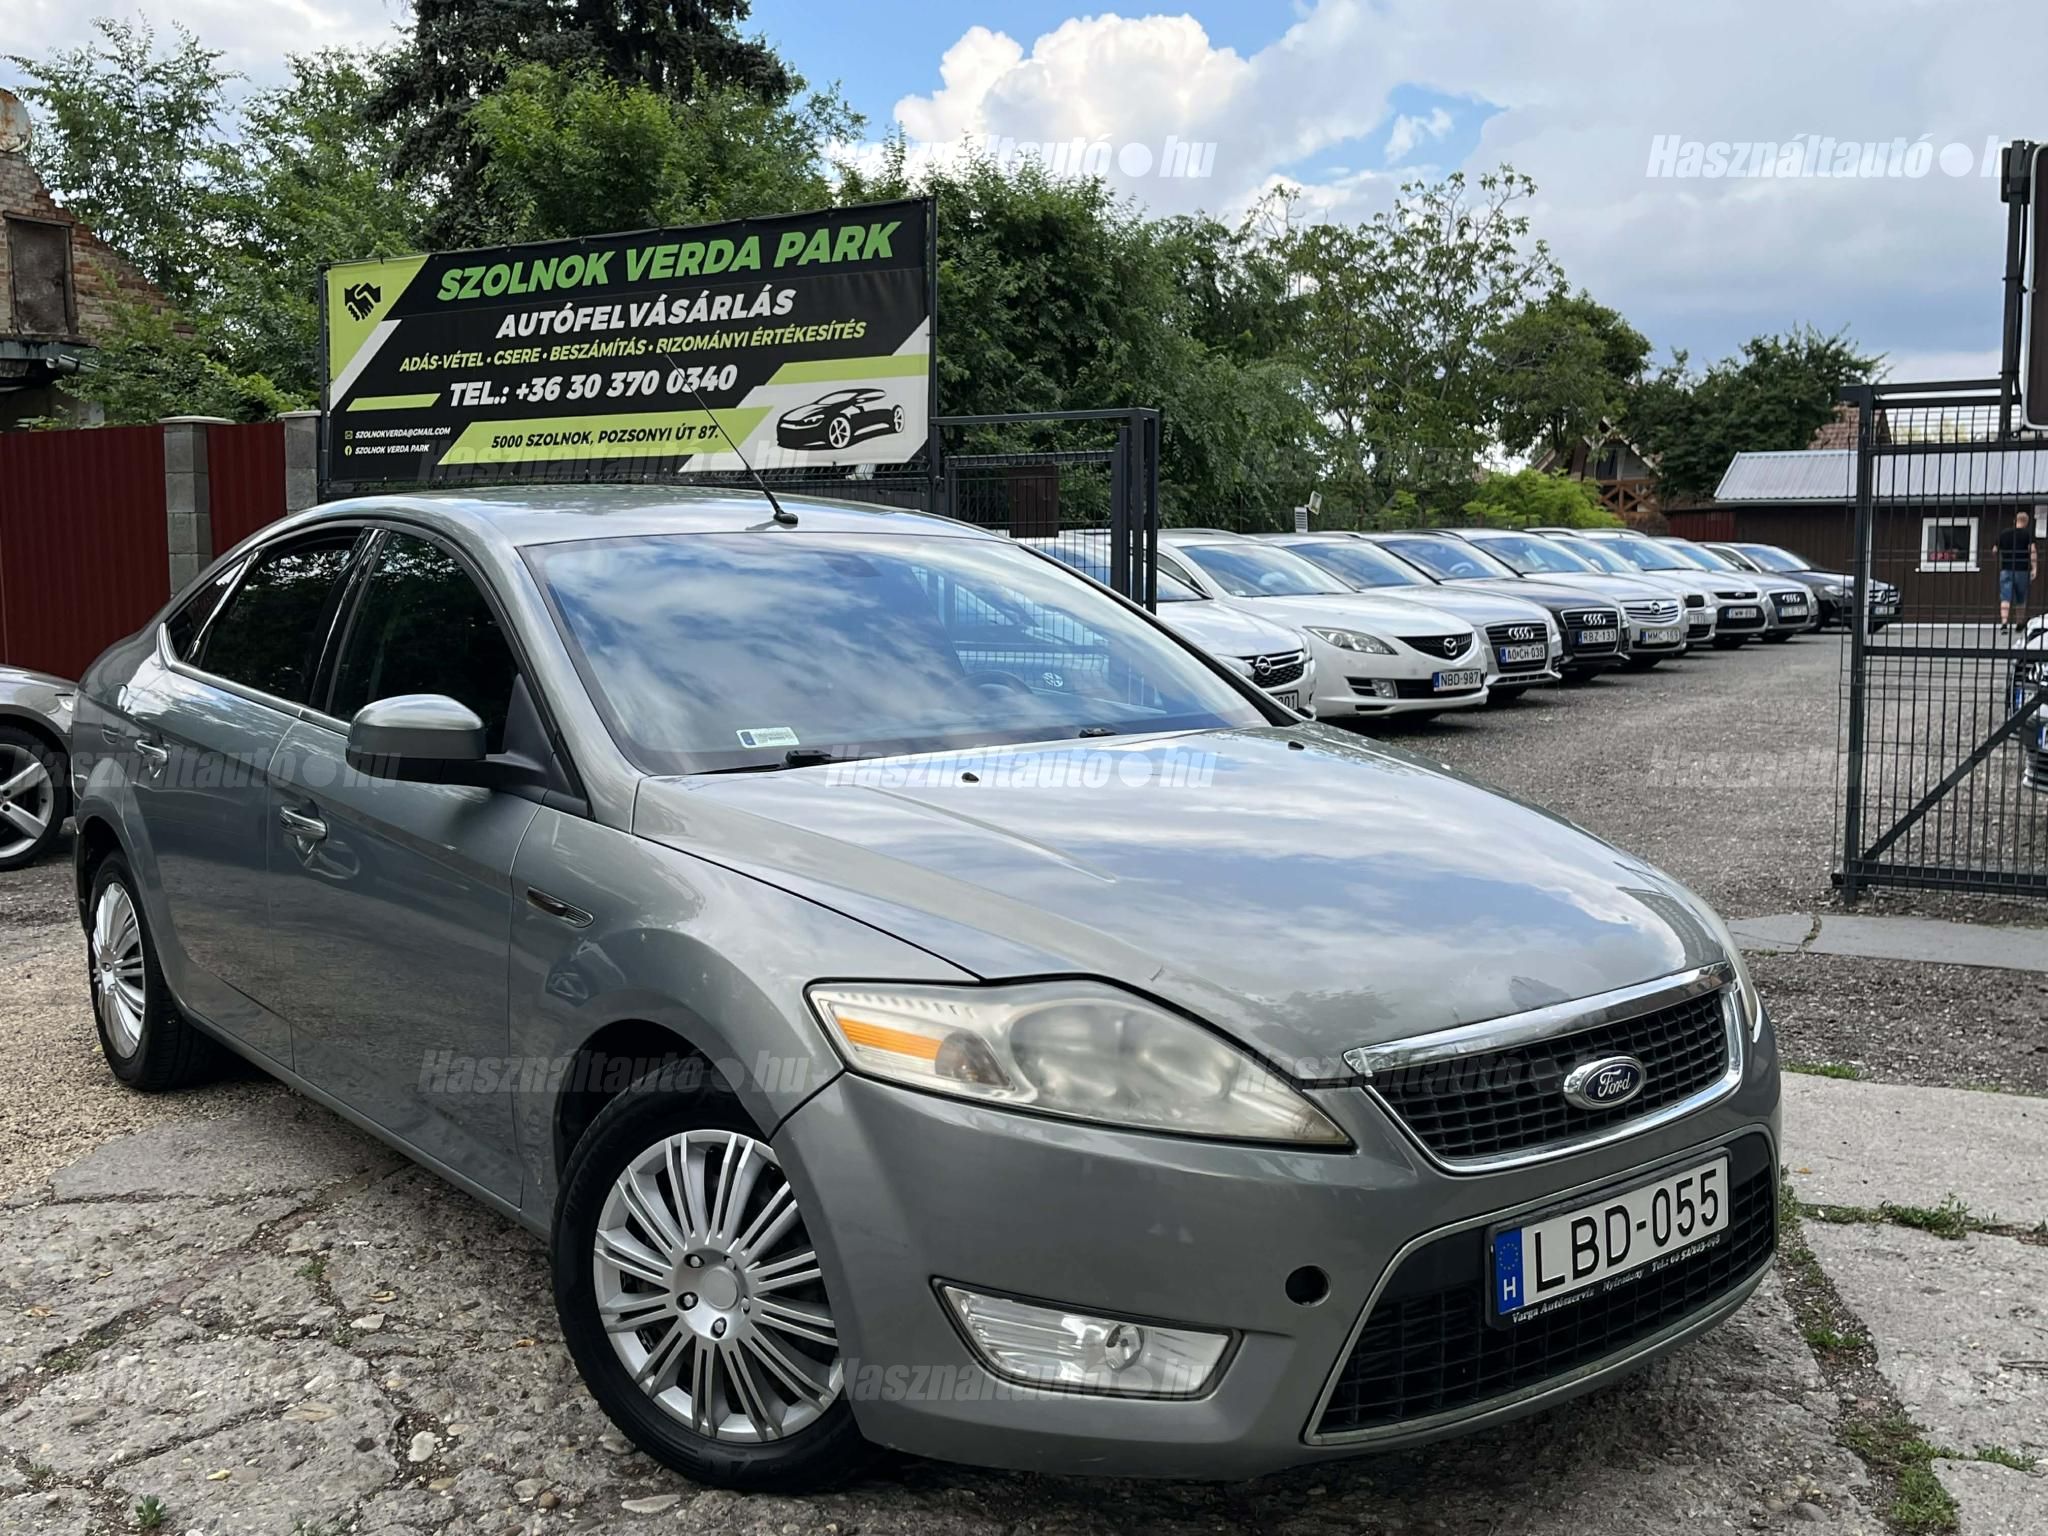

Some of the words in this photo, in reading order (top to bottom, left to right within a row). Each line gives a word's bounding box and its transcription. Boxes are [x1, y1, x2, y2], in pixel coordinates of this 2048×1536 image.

[437, 250, 616, 301] SZOLNOK
[626, 236, 761, 282] VERDA
[773, 221, 902, 268] PARK
[496, 284, 797, 339] AUTÓFELVÁSÁRLÁS
[400, 349, 484, 372] ADÁS-VÉTEL
[494, 347, 542, 365] CSERE
[550, 337, 647, 361] BESZÁMÍTÁS
[656, 330, 750, 354] BIZOMÁNYI
[751, 318, 867, 347] ÉRTÉKESÍTÉS
[450, 380, 508, 407] TEL.:
[516, 376, 563, 402] +36
[566, 374, 601, 399] 30
[606, 370, 660, 398] 370
[666, 364, 738, 394] 0340
[355, 446, 386, 455] SZOLNOK
[387, 445, 409, 454] VERDA
[410, 444, 430, 453] PARK
[491, 435, 523, 448] 5000
[525, 431, 594, 448] SZOLNOK,
[598, 427, 671, 444] POZSONYI
[677, 422, 697, 440] ÚT
[698, 425, 719, 440] 87.
[1441, 672, 1479, 686] NBD-987
[1597, 1067, 1631, 1097] Ford
[1534, 1168, 1719, 1293] LBD-055
